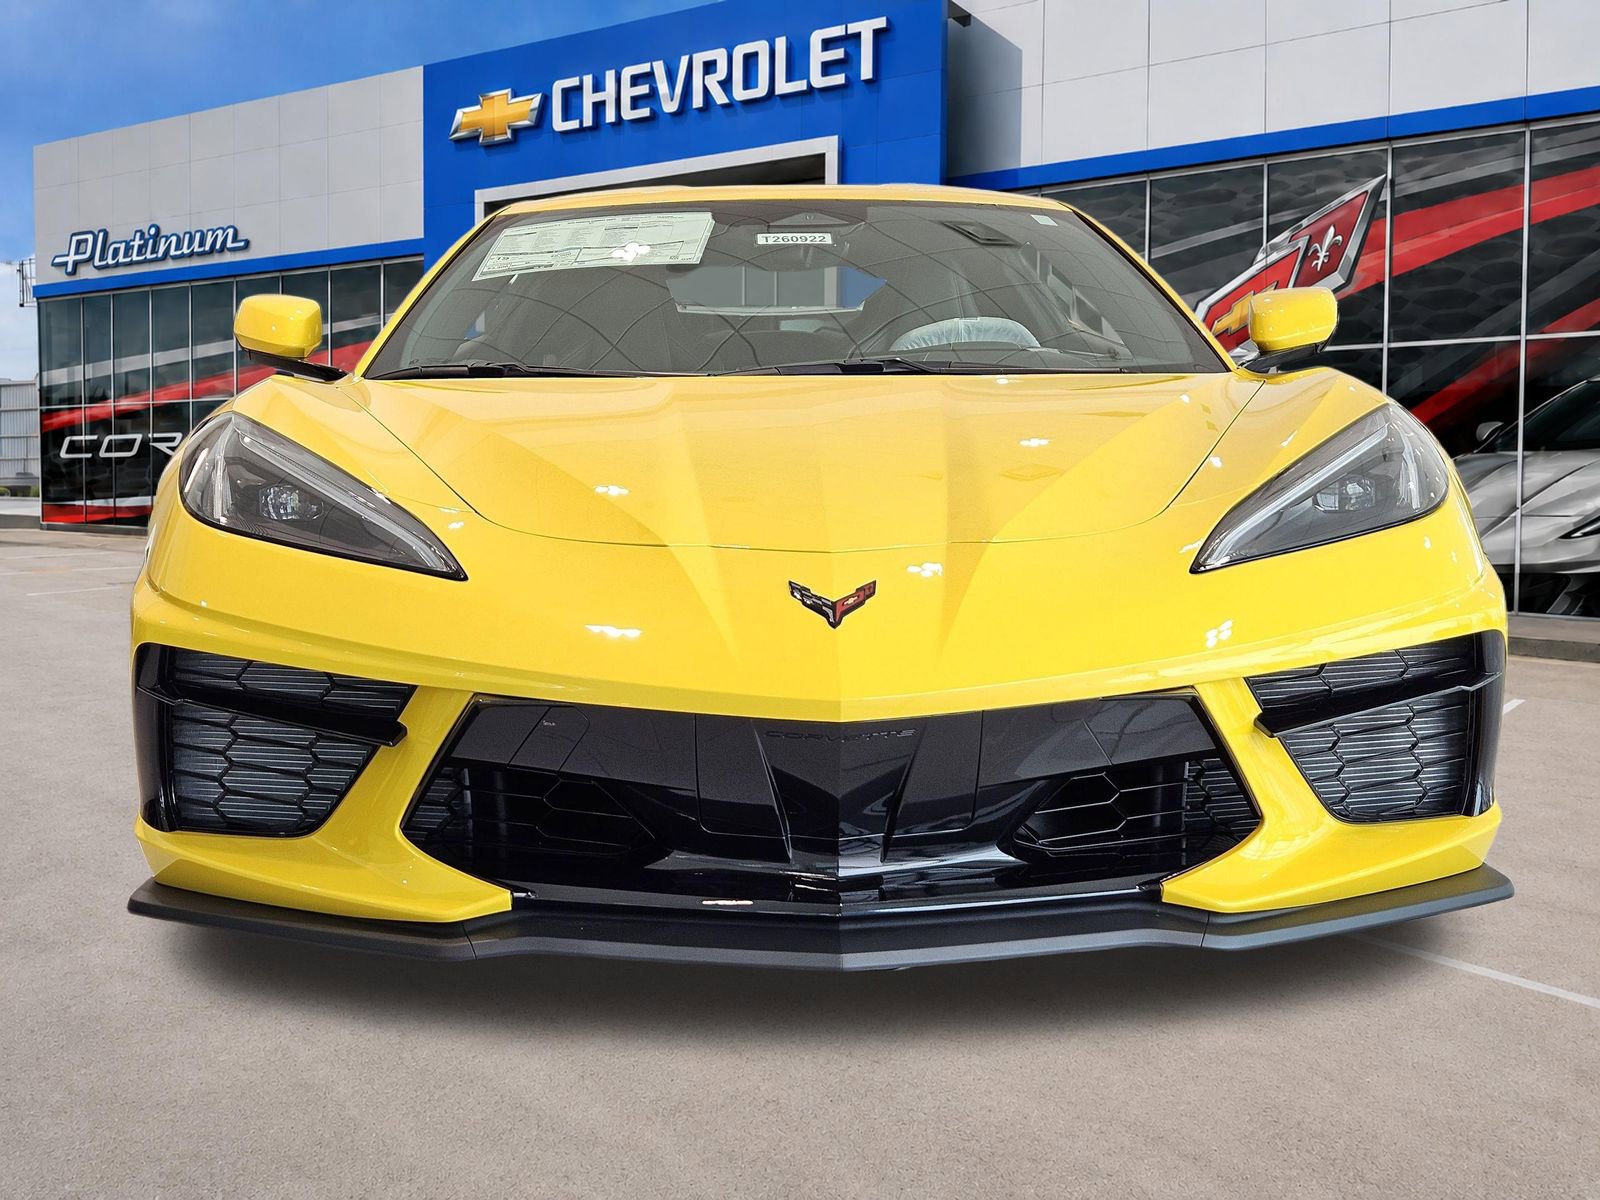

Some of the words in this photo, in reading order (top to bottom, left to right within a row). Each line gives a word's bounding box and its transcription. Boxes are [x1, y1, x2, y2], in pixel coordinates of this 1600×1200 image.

[551, 15, 888, 133] CHEVROLET
[52, 224, 250, 275] Platinum
[761, 235, 827, 243] T260922
[60, 432, 183, 459] COR
